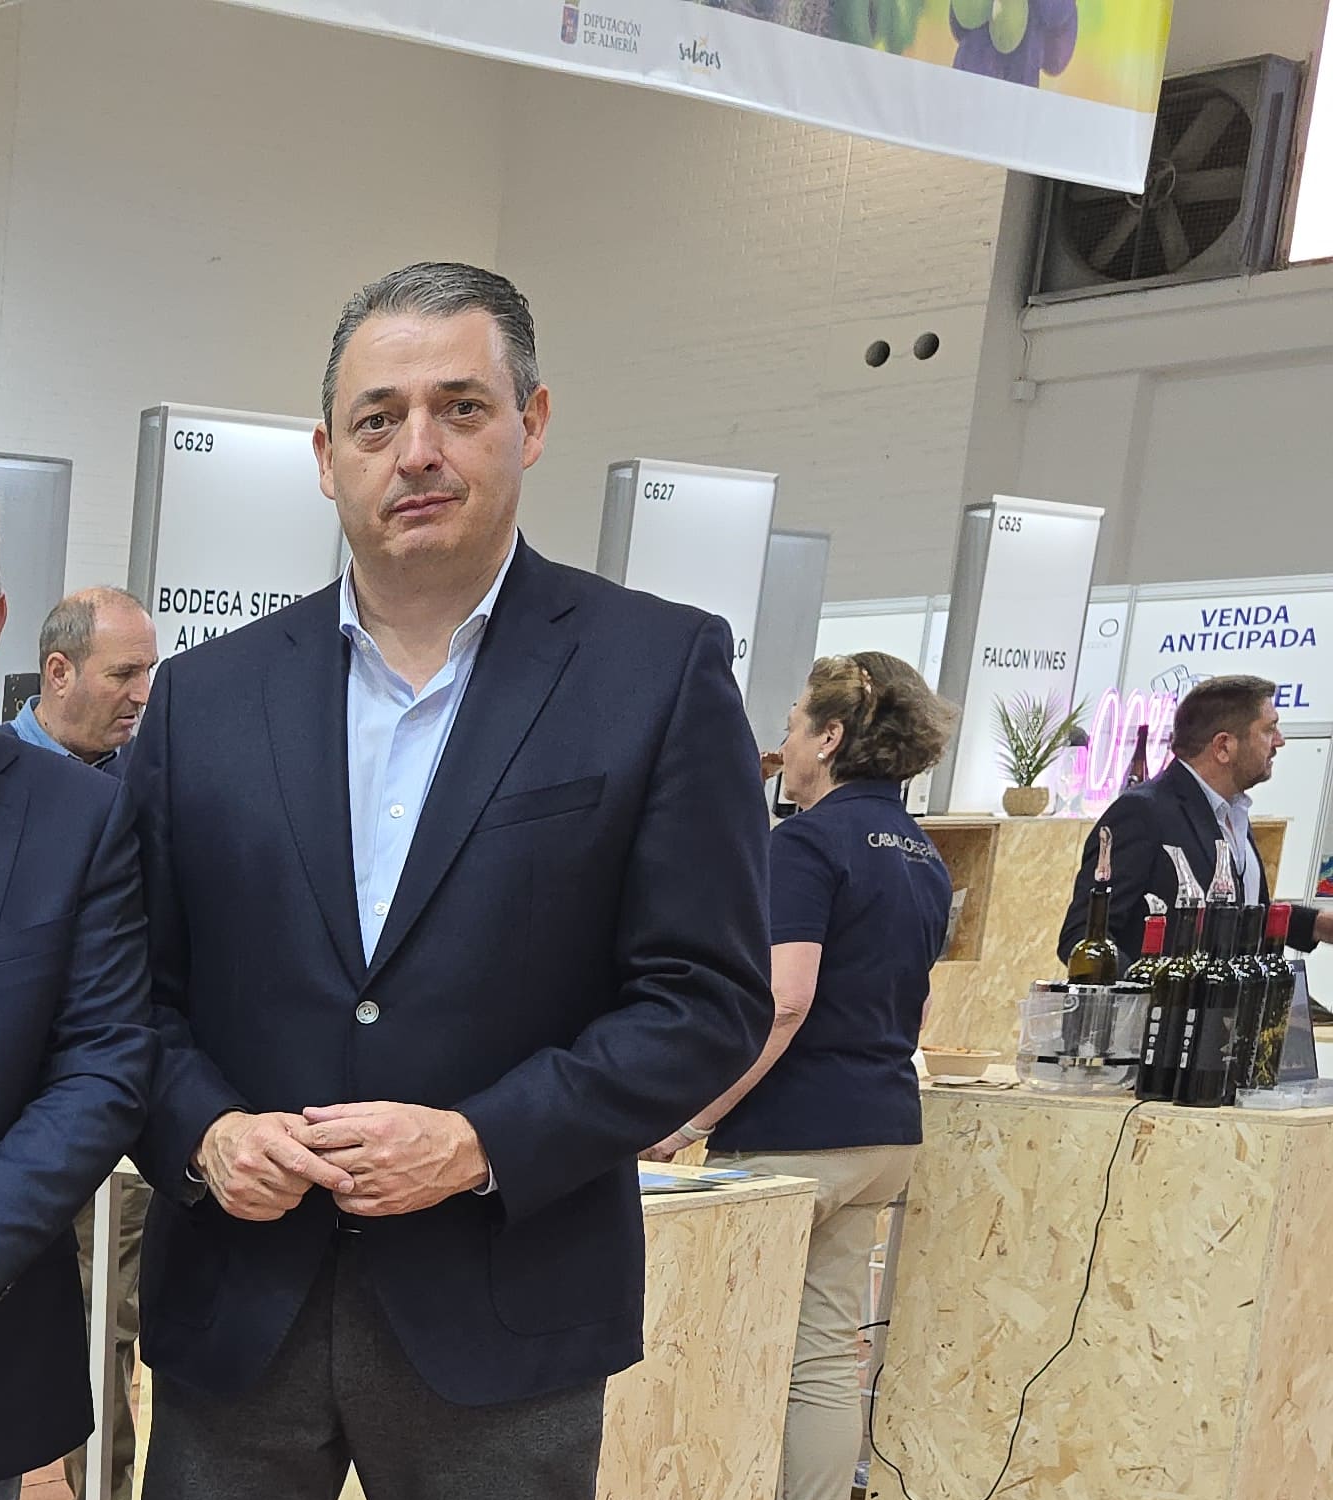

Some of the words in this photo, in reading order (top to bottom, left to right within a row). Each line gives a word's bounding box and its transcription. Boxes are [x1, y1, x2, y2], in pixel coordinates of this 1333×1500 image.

[583, 13, 641, 37] DIPUTACIÓN
[583, 31, 596, 45] DE
[598, 32, 638, 54] ALMERÍA
[174, 430, 214, 452] C629
[644, 482, 675, 501] C627
[998, 515, 1022, 532] C625
[159, 586, 243, 617] BODEGA
[1201, 605, 1290, 628] VENDA
[1159, 627, 1317, 653] ANTICIPADA
[982, 647, 1030, 669] FALCON
[1034, 650, 1067, 670] VINES
